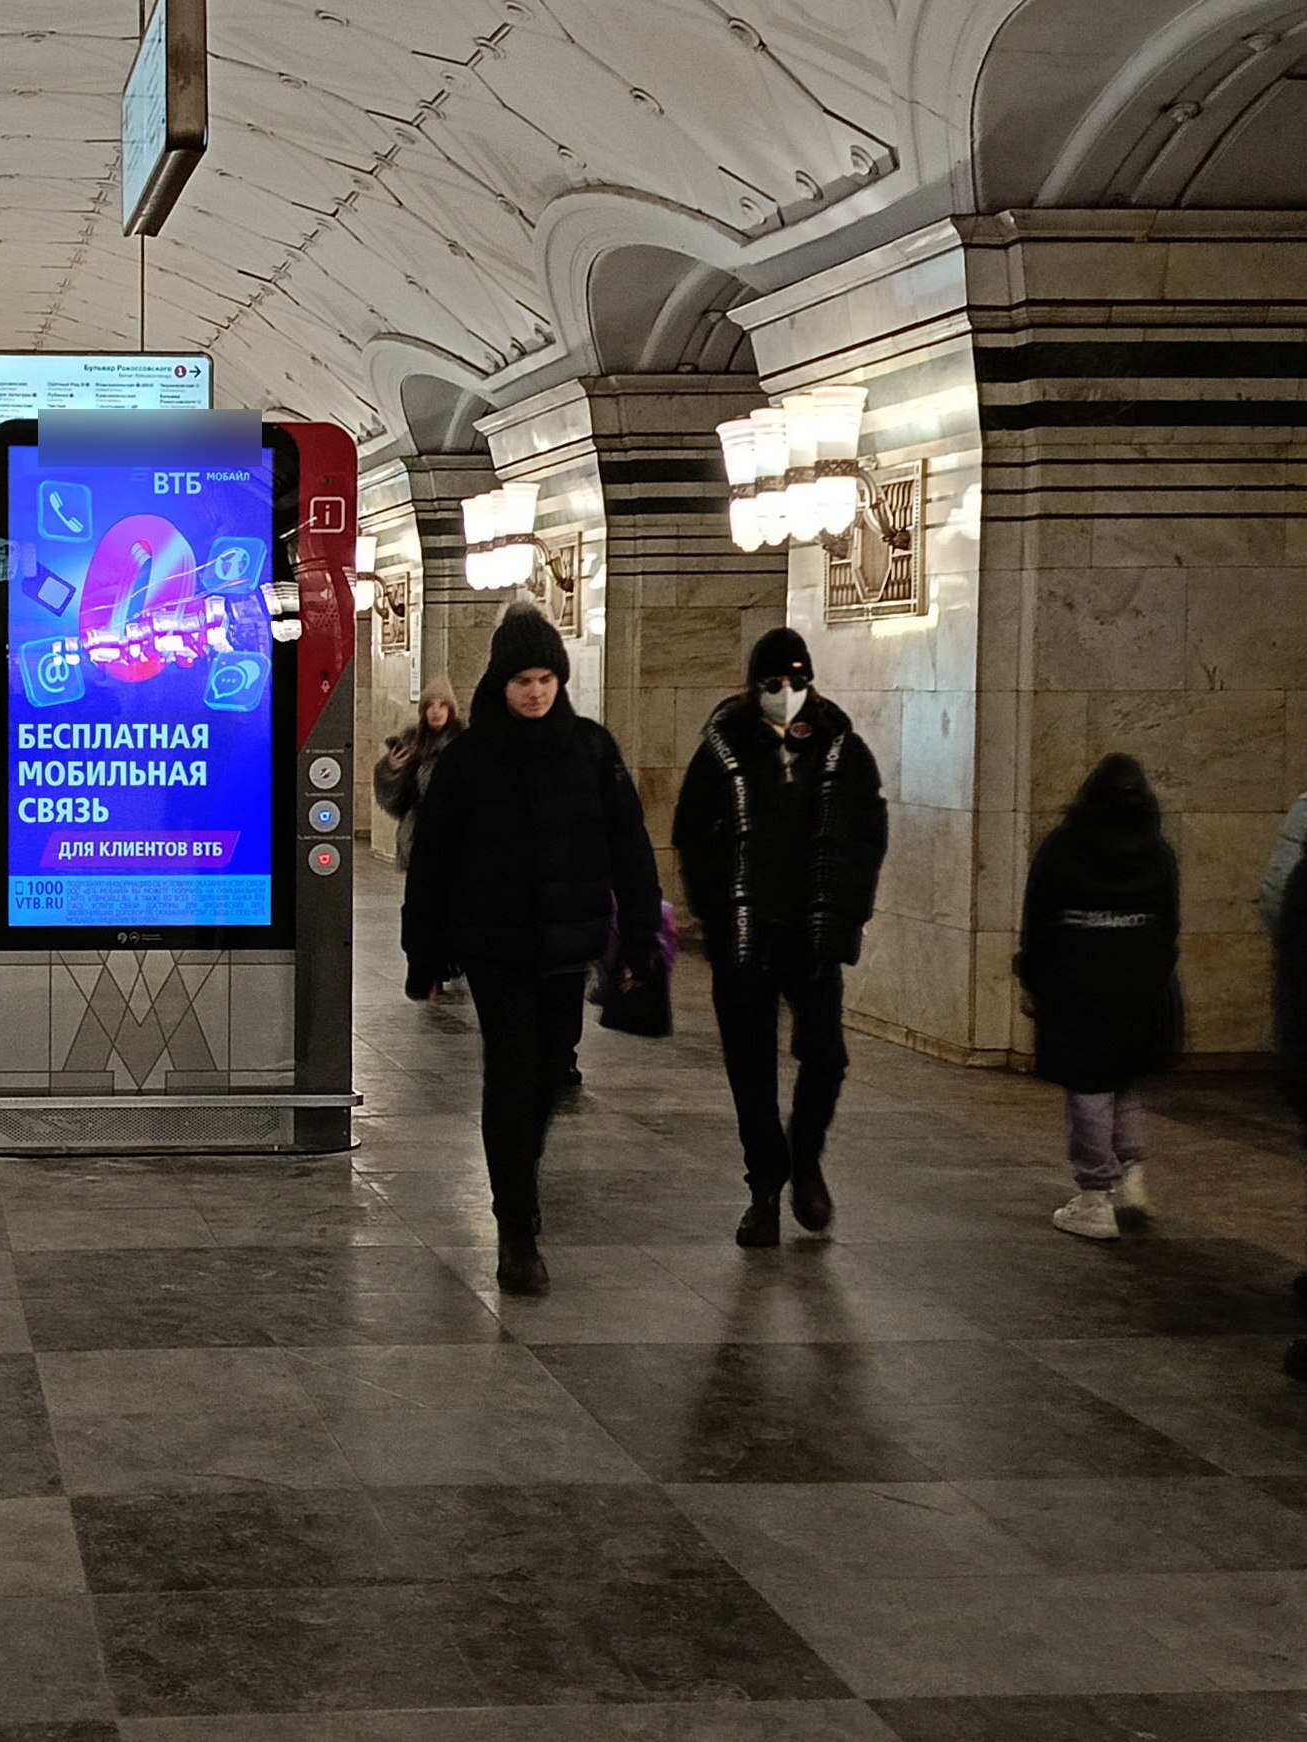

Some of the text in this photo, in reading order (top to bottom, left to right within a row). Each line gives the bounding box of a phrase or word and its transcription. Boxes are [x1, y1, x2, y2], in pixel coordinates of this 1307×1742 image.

[83, 364, 115, 373] Бульвар
[117, 364, 173, 373] Рокоссовского
[153, 471, 250, 495] ВТБ МОБАЙЛ
[18, 723, 209, 749] БЕСПЛАТНАЯ
[18, 760, 207, 786] МОБИЛЬНАЯ
[18, 797, 110, 823] СВЯЗЬ
[58, 841, 223, 860] ДЛЯ КЛИЕНТОВ ВТБ
[27, 881, 64, 895] 1000
[15, 897, 64, 909] VTB.RU
